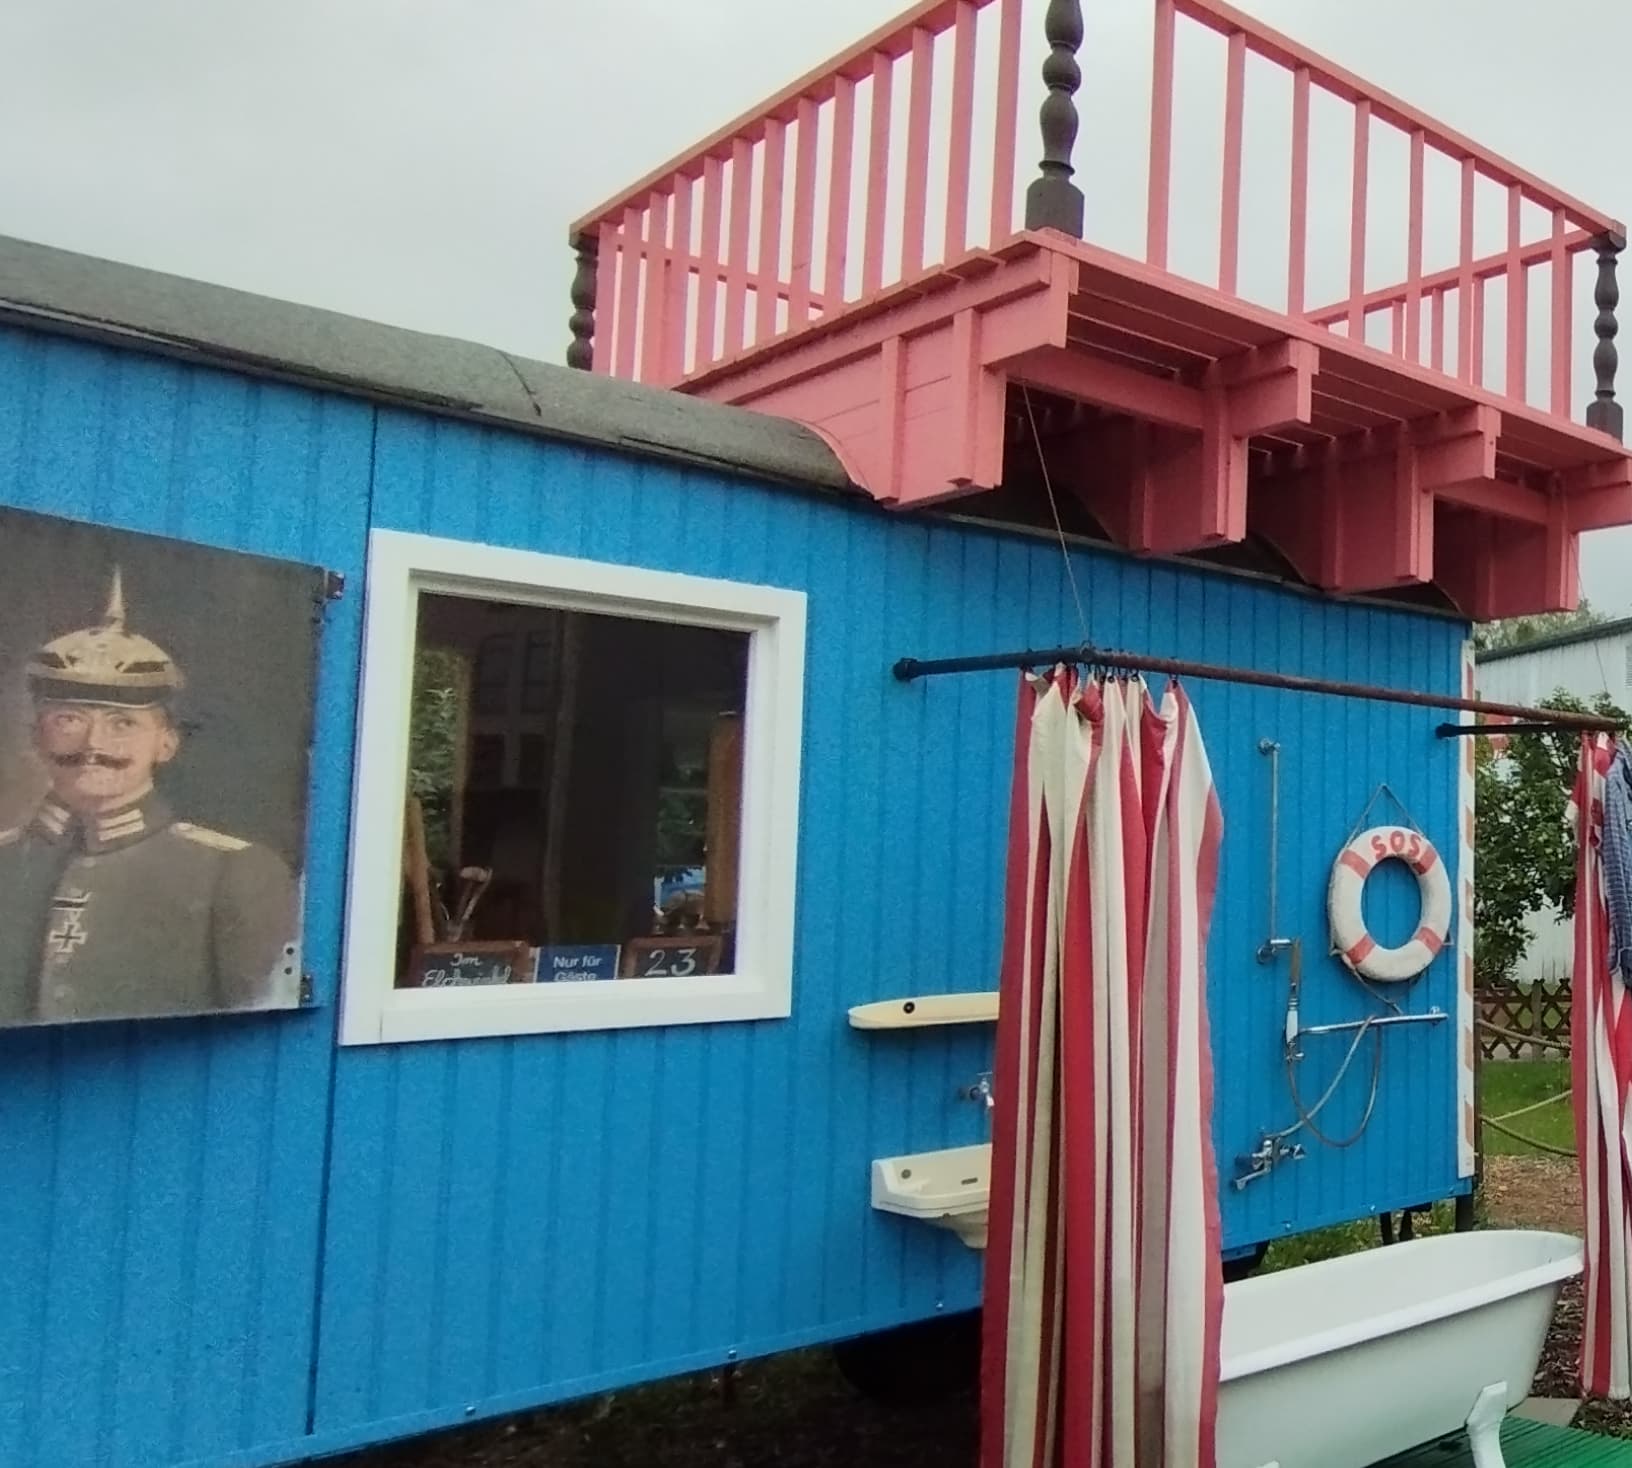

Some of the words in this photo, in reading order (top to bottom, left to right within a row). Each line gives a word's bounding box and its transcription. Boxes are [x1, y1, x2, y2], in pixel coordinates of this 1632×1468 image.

[1371, 830, 1422, 860] SOS
[553, 956, 580, 968] Nur
[582, 955, 602, 967] für
[645, 948, 696, 976] 23
